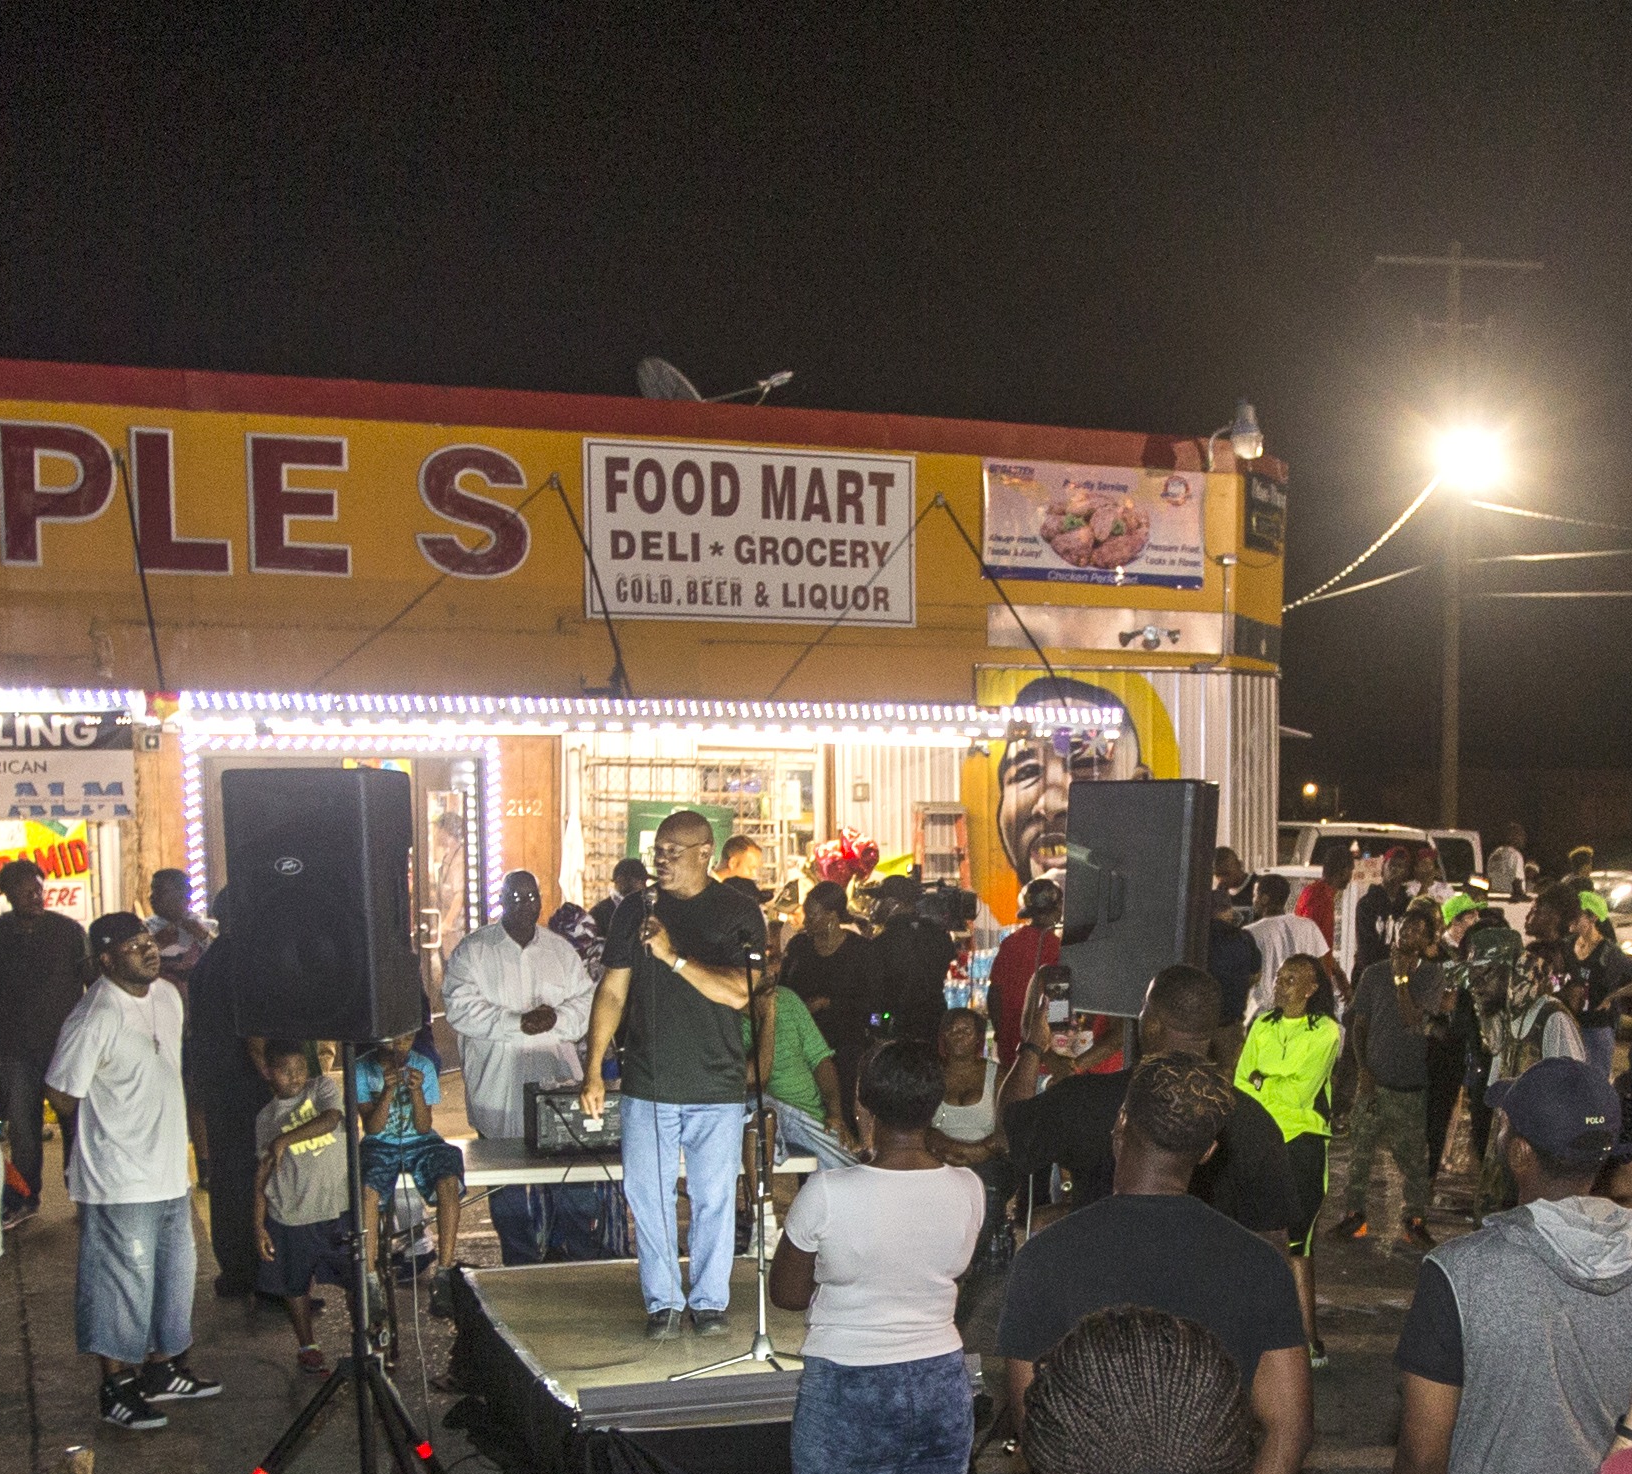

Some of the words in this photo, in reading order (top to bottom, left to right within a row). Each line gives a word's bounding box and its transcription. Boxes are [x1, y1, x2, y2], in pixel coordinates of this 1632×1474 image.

[605, 456, 741, 518] FOOD
[760, 464, 896, 527] MART
[415, 443, 532, 581] S
[610, 529, 701, 563] DELI
[733, 534, 892, 569] GROCERY
[1047, 569, 1089, 582] Chicken
[754, 580, 770, 608] &
[781, 582, 891, 612] LIQUOR
[1585, 1115, 1606, 1125] POLO
